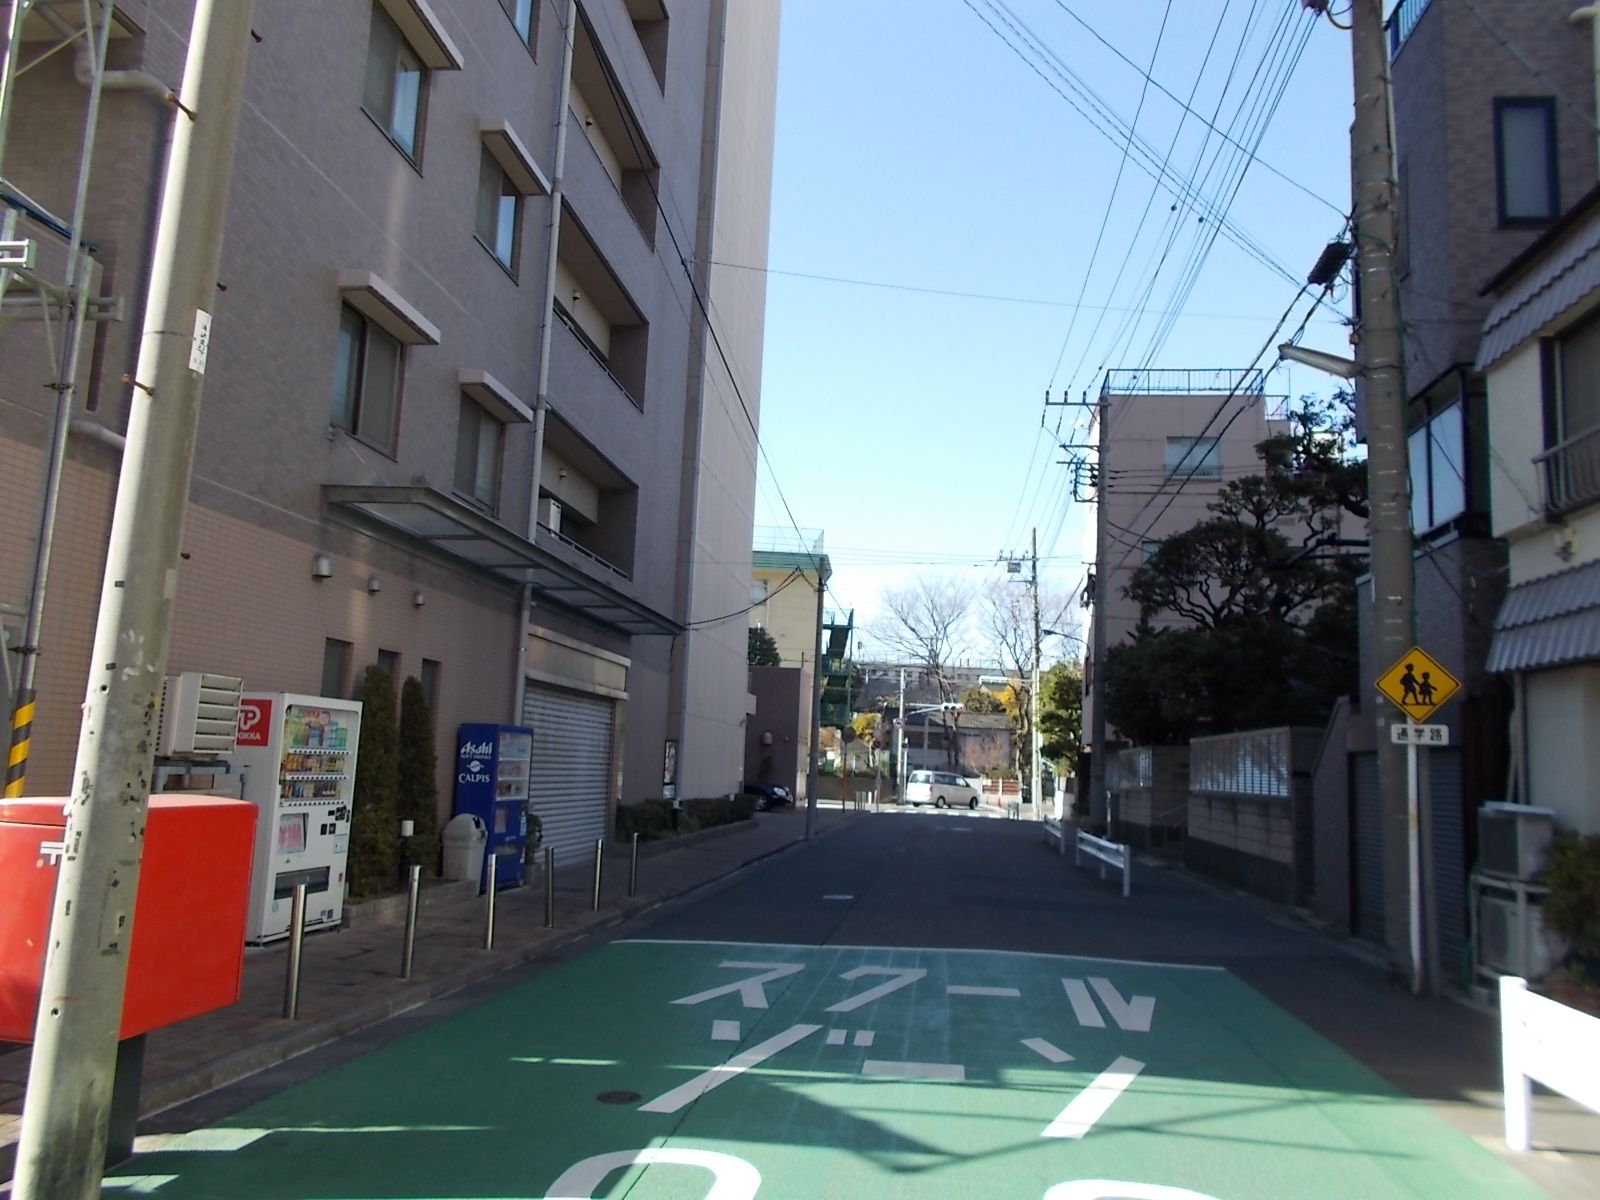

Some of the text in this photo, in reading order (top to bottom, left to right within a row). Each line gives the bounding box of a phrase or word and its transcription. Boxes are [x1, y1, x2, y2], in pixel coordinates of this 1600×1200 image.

[238, 732, 261, 740] OKKA
[1397, 727, 1442, 741] 通学路
[461, 741, 493, 755] Asahi
[458, 773, 490, 783] CALPIS
[670, 961, 1156, 1031] スクール
[636, 1020, 1146, 1139] ゾーン
